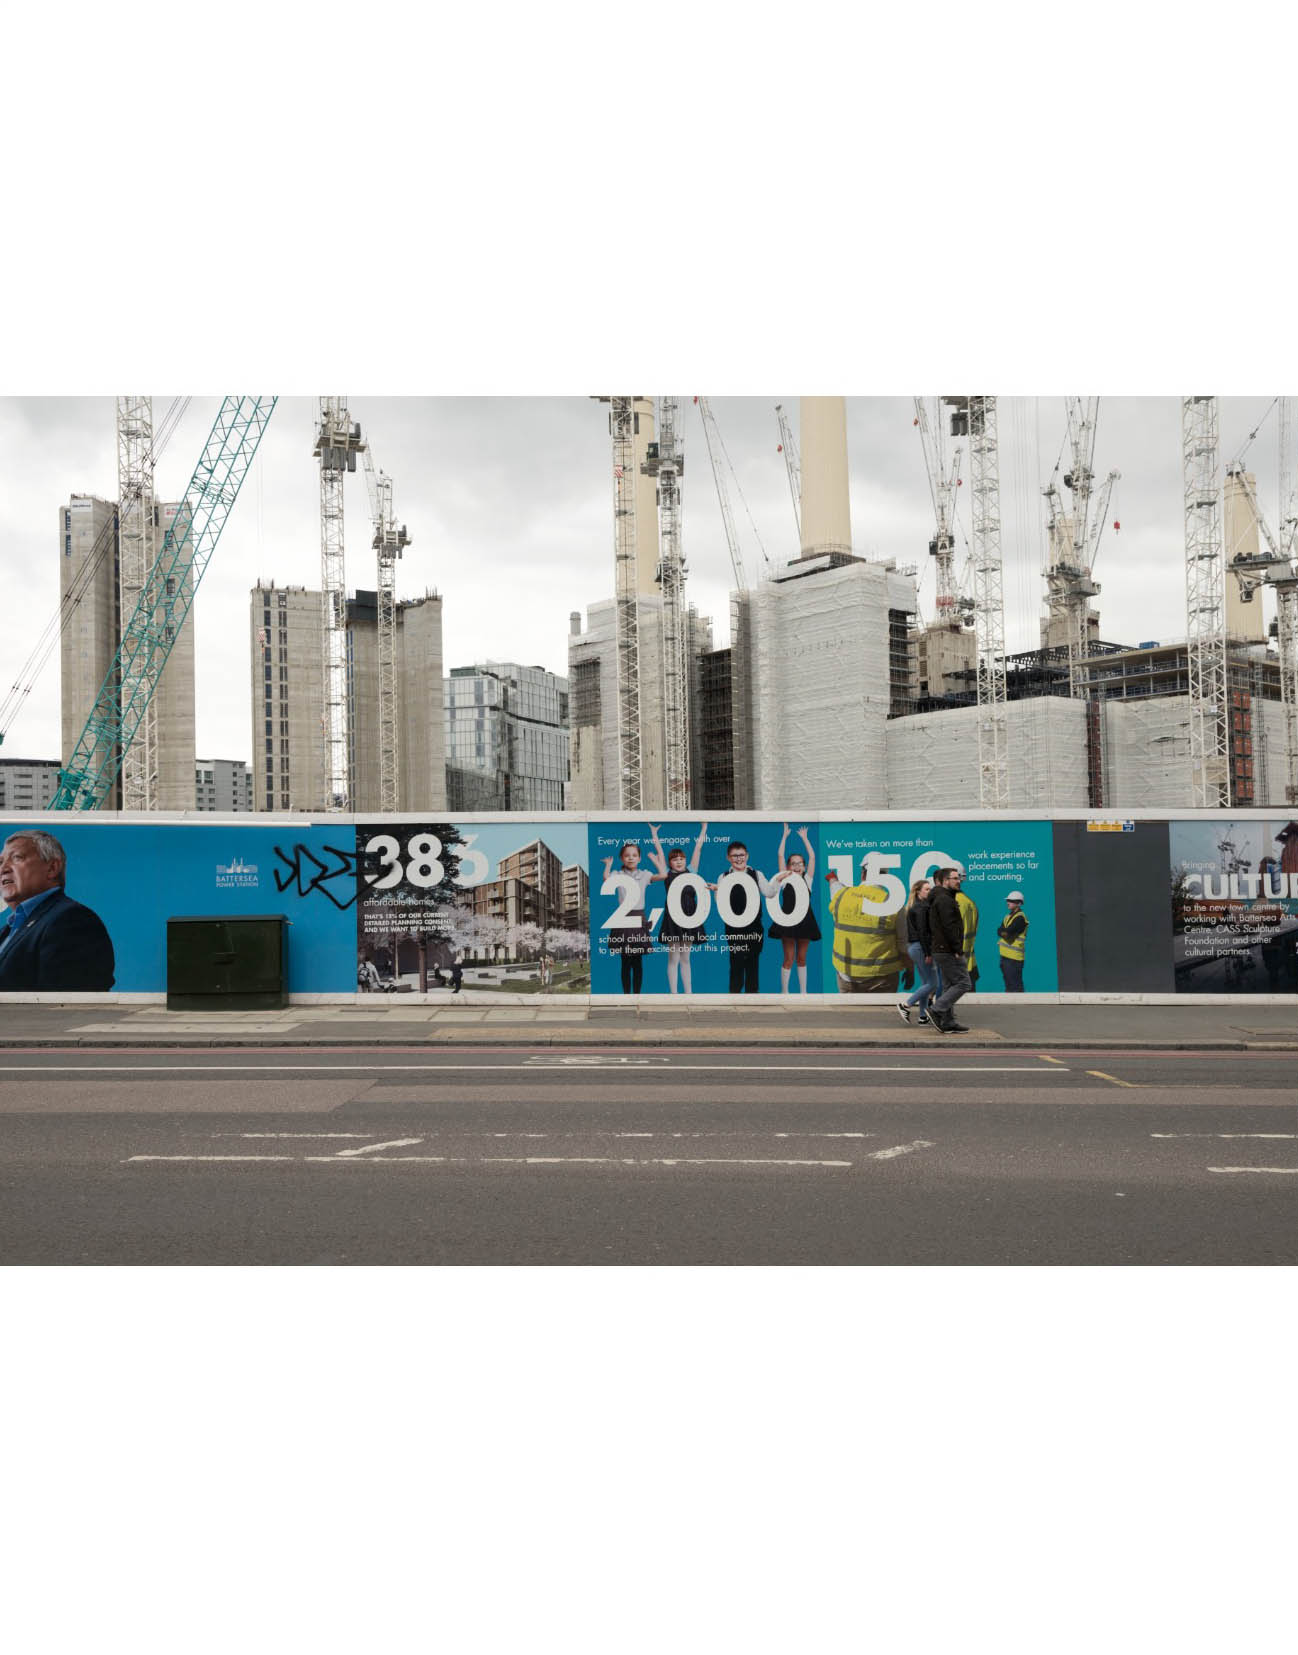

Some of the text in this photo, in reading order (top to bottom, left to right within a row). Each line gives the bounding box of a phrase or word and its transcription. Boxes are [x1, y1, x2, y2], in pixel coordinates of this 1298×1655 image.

[597, 836, 620, 847] Every
[623, 838, 640, 847] year
[659, 837, 690, 846] engage
[826, 840, 853, 848] We've
[855, 839, 877, 848] taken
[916, 838, 933, 847] than
[968, 850, 1035, 861] work experience
[968, 862, 1014, 872] placements
[1028, 861, 1039, 869] far
[968, 872, 1025, 883] and counting.
[363, 896, 435, 907] affordable homes
[600, 871, 810, 932] 2,000
[1183, 903, 1191, 912] to
[1194, 902, 1206, 911] the
[1229, 903, 1249, 911] town
[1252, 902, 1277, 910] centre
[1280, 901, 1290, 911] by
[1183, 912, 1296, 925] working with Battersea Arts
[1183, 924, 1280, 935] Centre, CASS Sculpture
[599, 932, 763, 944] school children from the local community
[1184, 935, 1272, 945] Foundation and other
[599, 943, 750, 957] to get them excited about this project.
[1184, 946, 1252, 957] cultural partners.
